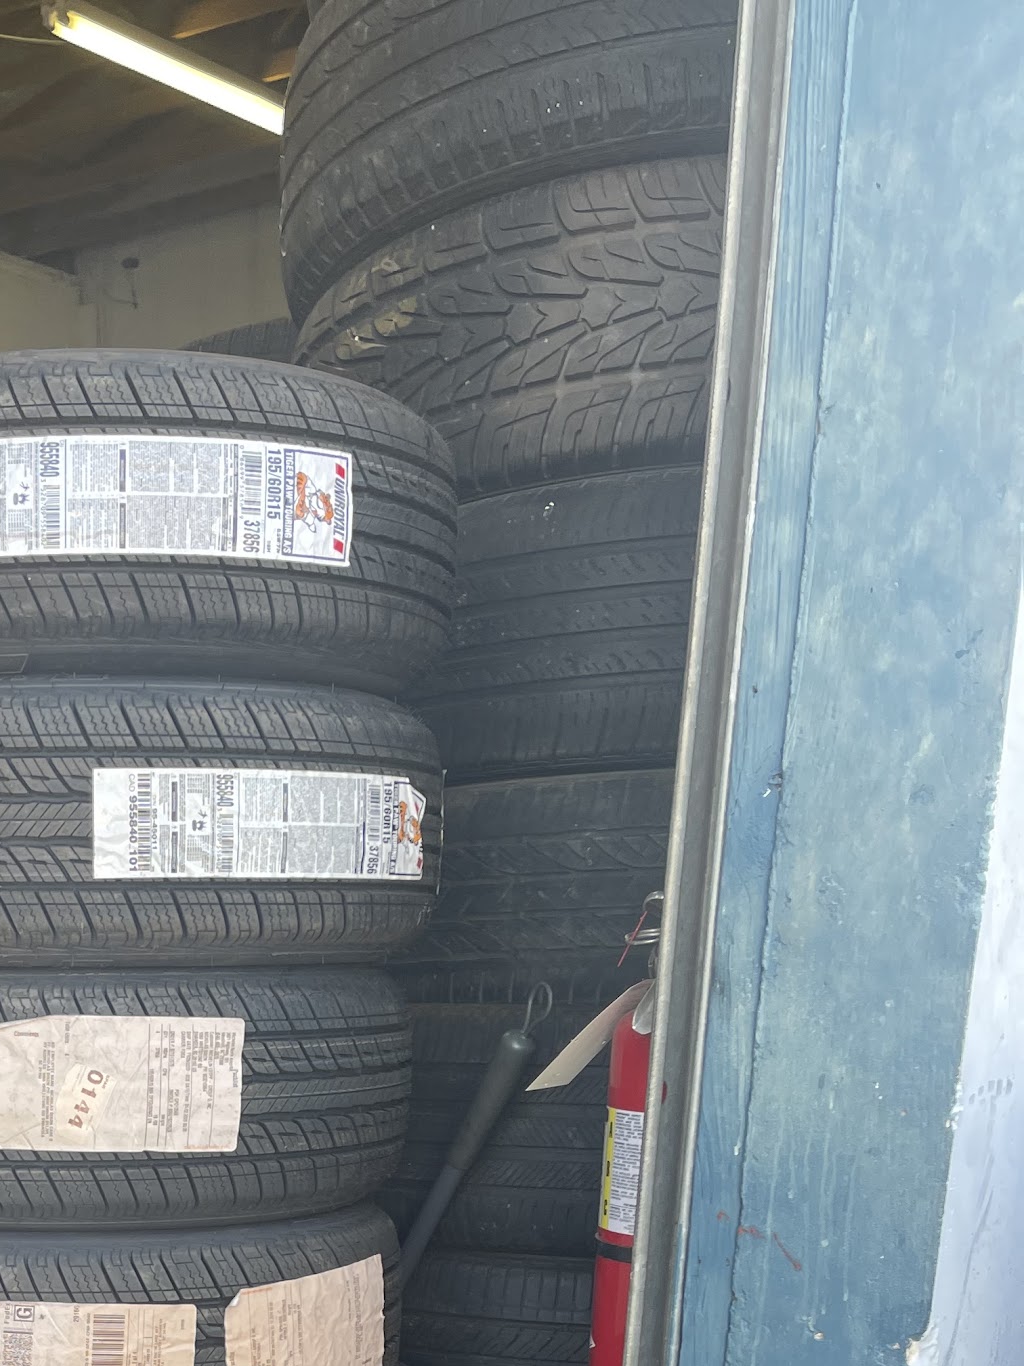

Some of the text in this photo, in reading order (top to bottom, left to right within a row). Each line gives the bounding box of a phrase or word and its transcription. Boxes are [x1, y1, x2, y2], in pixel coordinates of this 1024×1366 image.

[39, 442, 61, 477] 955840
[285, 451, 294, 477] TIGER
[266, 448, 282, 520] 195/60R15
[283, 505, 294, 538] TOURING
[332, 477, 346, 540] UNIROYAL
[242, 520, 261, 553] 37856
[282, 540, 292, 554] A/S
[215, 774, 235, 808] 955840
[382, 781, 393, 844] 195/60R15
[366, 845, 379, 874] 37856
[67, 1069, 105, 1130] 0144
[16, 1306, 34, 1320] G
